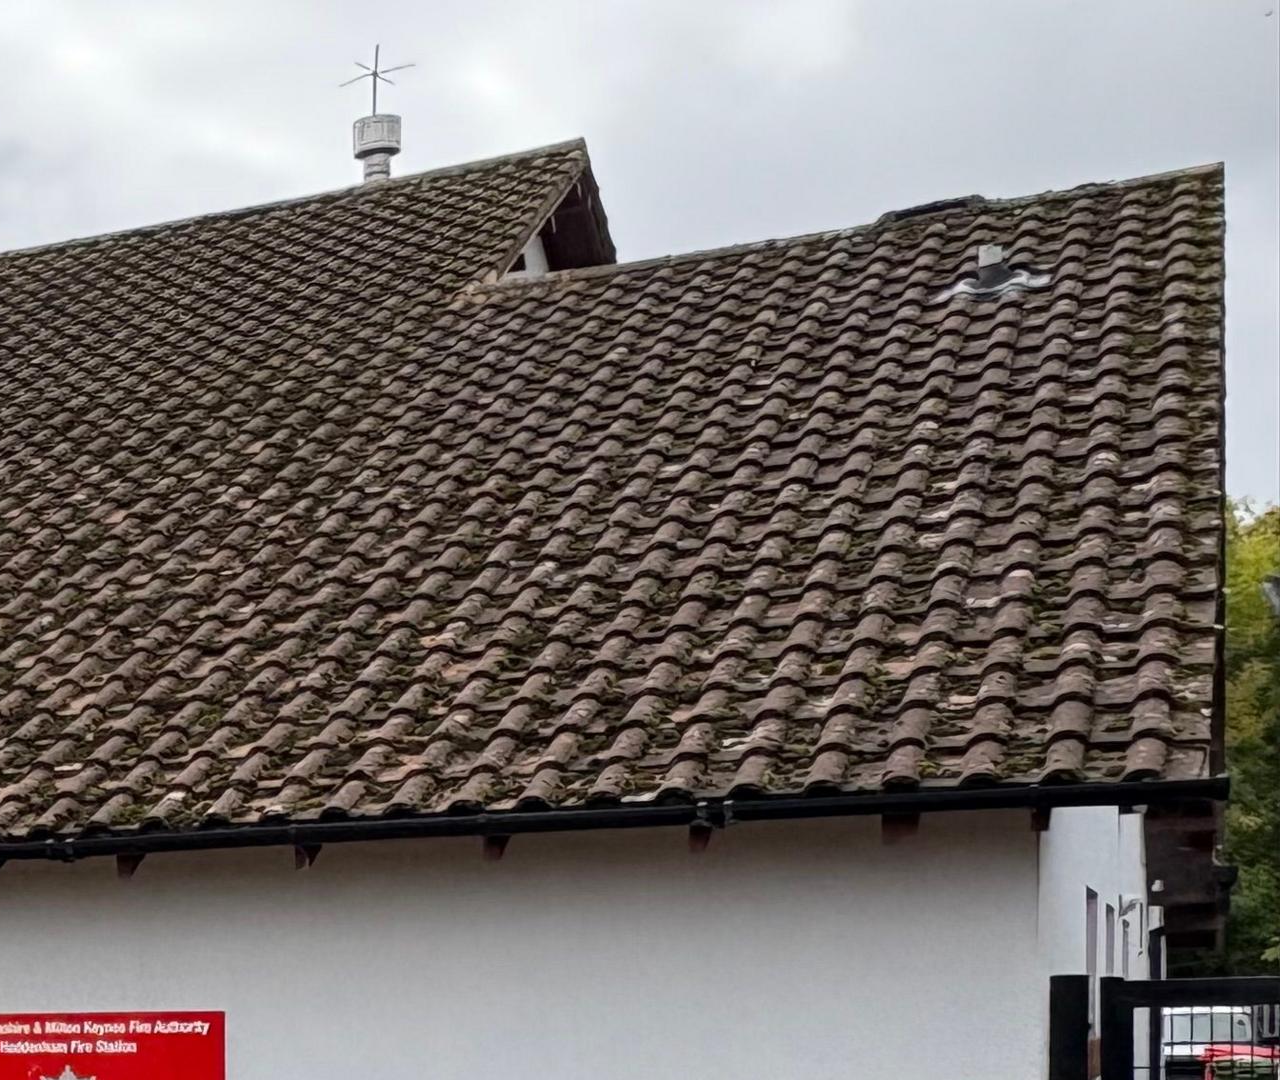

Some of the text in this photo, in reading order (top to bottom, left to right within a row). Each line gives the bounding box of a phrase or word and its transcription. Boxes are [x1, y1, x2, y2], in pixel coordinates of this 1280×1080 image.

[33, 1021, 42, 1034] &
[45, 1021, 80, 1034] Milton
[83, 1020, 126, 1036] Keynes
[129, 1020, 152, 1034] Fire
[153, 1020, 210, 1035] Authority
[70, 1040, 93, 1053] Fire
[95, 1039, 137, 1053] Station
